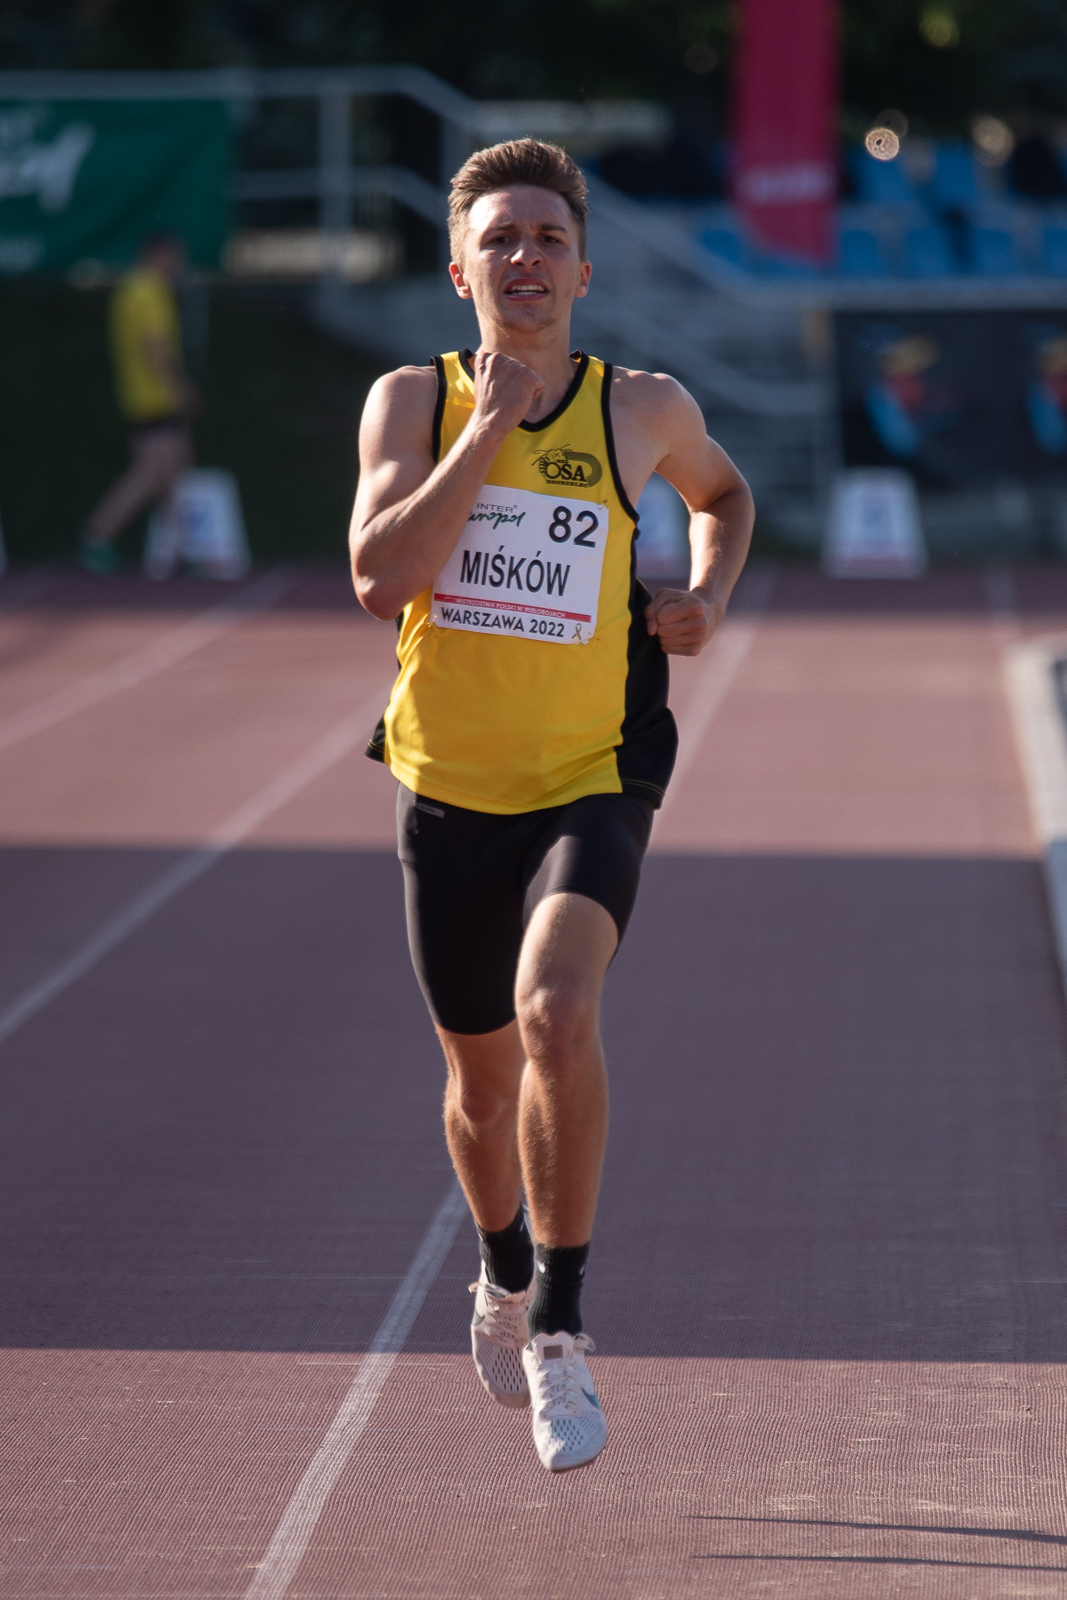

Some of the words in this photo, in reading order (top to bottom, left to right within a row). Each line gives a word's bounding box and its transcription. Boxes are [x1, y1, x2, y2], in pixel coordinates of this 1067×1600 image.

[546, 461, 587, 482] OSA
[467, 511, 526, 530] uropol
[548, 506, 599, 548] 82
[460, 545, 571, 597] MIŚKÓW
[456, 598, 495, 608] MISTRZOSTWA
[496, 603, 516, 611] POLSKI
[524, 607, 566, 618] WIELOBOJACH
[441, 607, 525, 632] WARSZAWA
[529, 618, 565, 638] 2022
